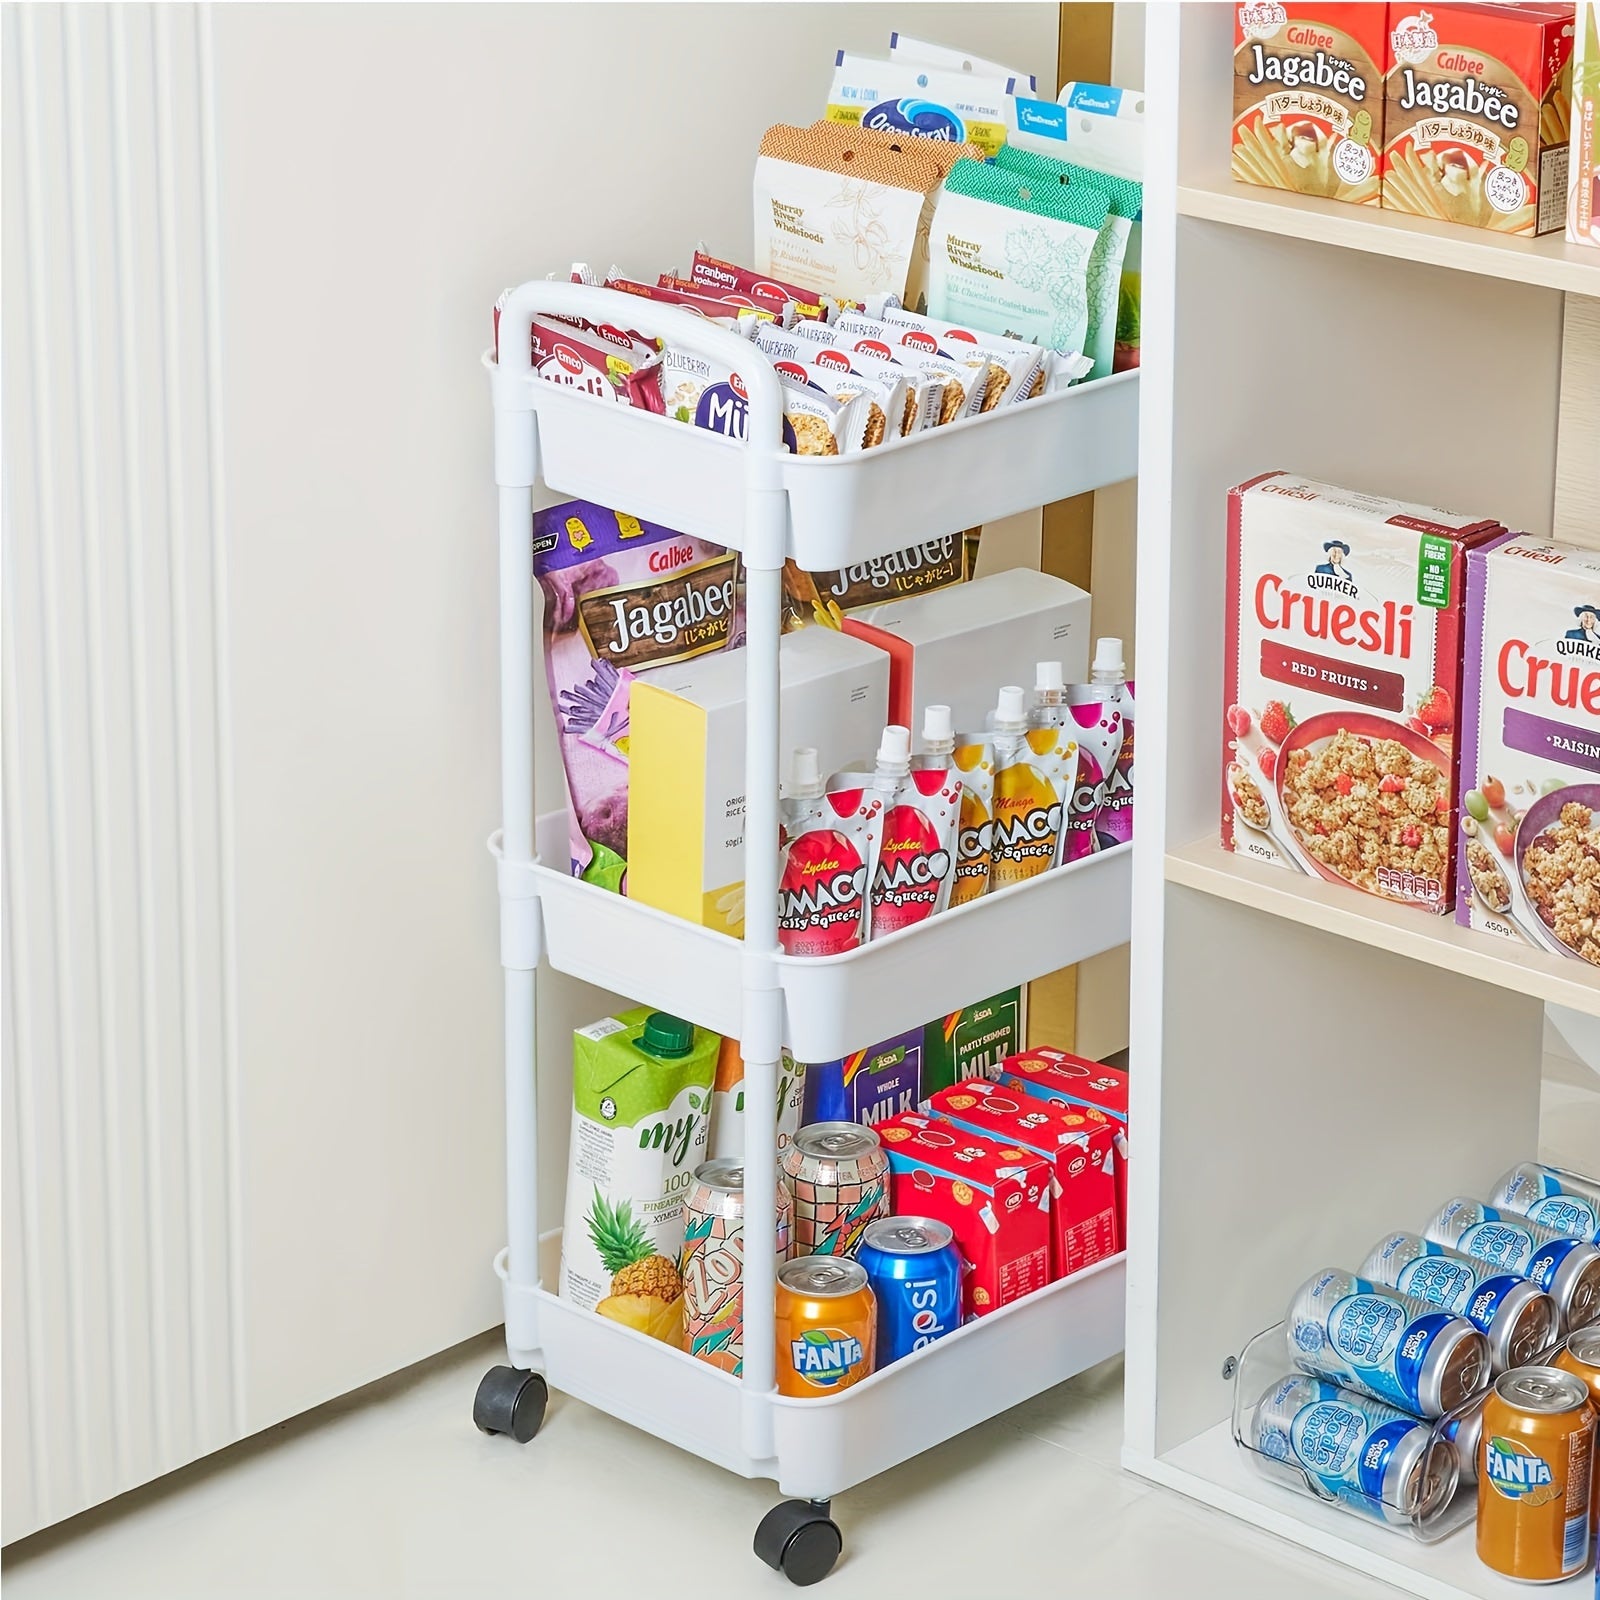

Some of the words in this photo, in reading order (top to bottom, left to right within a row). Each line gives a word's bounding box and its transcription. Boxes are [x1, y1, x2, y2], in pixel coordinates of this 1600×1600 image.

[1287, 27, 1334, 49] Calbee
[1249, 45, 1366, 101] Jagabee
[1437, 52, 1485, 75] Calbee
[842, 86, 858, 99] NEW
[1400, 69, 1519, 129] Jagabee
[1270, 95, 1344, 123] バターしょうゆ味
[1420, 121, 1496, 152] バターしょうゆ味
[771, 198, 804, 217] Murray
[773, 208, 796, 222] River
[946, 234, 981, 252] Murray
[946, 244, 972, 259] River
[695, 264, 738, 288] cranberry
[602, 328, 630, 347] Emco
[906, 336, 935, 352] Emco
[557, 350, 581, 368] Emco
[857, 343, 888, 360] Emco
[613, 360, 630, 372] NEW
[667, 351, 711, 377] BLUEBERRY
[775, 366, 805, 384] Emco
[819, 354, 848, 373] Emco
[1261, 483, 1321, 503] Cruesli
[649, 544, 694, 573] Calbee
[1424, 549, 1447, 561] FIBERS
[1504, 546, 1568, 565] Cruesli
[1429, 564, 1440, 574] NO
[1307, 574, 1359, 600] QUAKER
[609, 579, 733, 653] Jagabee
[1255, 573, 1414, 660] Cruesli
[1292, 661, 1317, 677] RED
[1321, 669, 1368, 691] FRUITS
[1552, 736, 1600, 759] RAISIN
[995, 796, 1034, 809] Mango
[883, 838, 921, 851] Lychee
[1005, 844, 1055, 862] Squeeze
[802, 858, 839, 876] Lychee
[884, 889, 936, 906] Squeeze
[810, 908, 861, 929] Squeeze
[973, 1007, 993, 1022] ASDA
[959, 1037, 982, 1056] PARTLY
[983, 1025, 1011, 1045] SKIMMED
[877, 1053, 898, 1068] ASDA
[961, 1042, 1009, 1082] MILK
[877, 1077, 900, 1094] WHOLE
[861, 1088, 912, 1127] MILK
[639, 1113, 700, 1167] my
[1469, 1294, 1486, 1318] Value
[1476, 1290, 1496, 1320] Great
[1338, 1297, 1377, 1352] Water
[1352, 1301, 1391, 1355] Soda
[791, 1338, 863, 1371] FANTA
[1401, 1335, 1416, 1357] Value
[1407, 1330, 1427, 1359] Great
[1301, 1404, 1339, 1461] Water
[1316, 1408, 1353, 1465] Soda
[1363, 1443, 1379, 1468] Value
[1369, 1439, 1389, 1470] Great
[1486, 1442, 1553, 1484] FANTA
